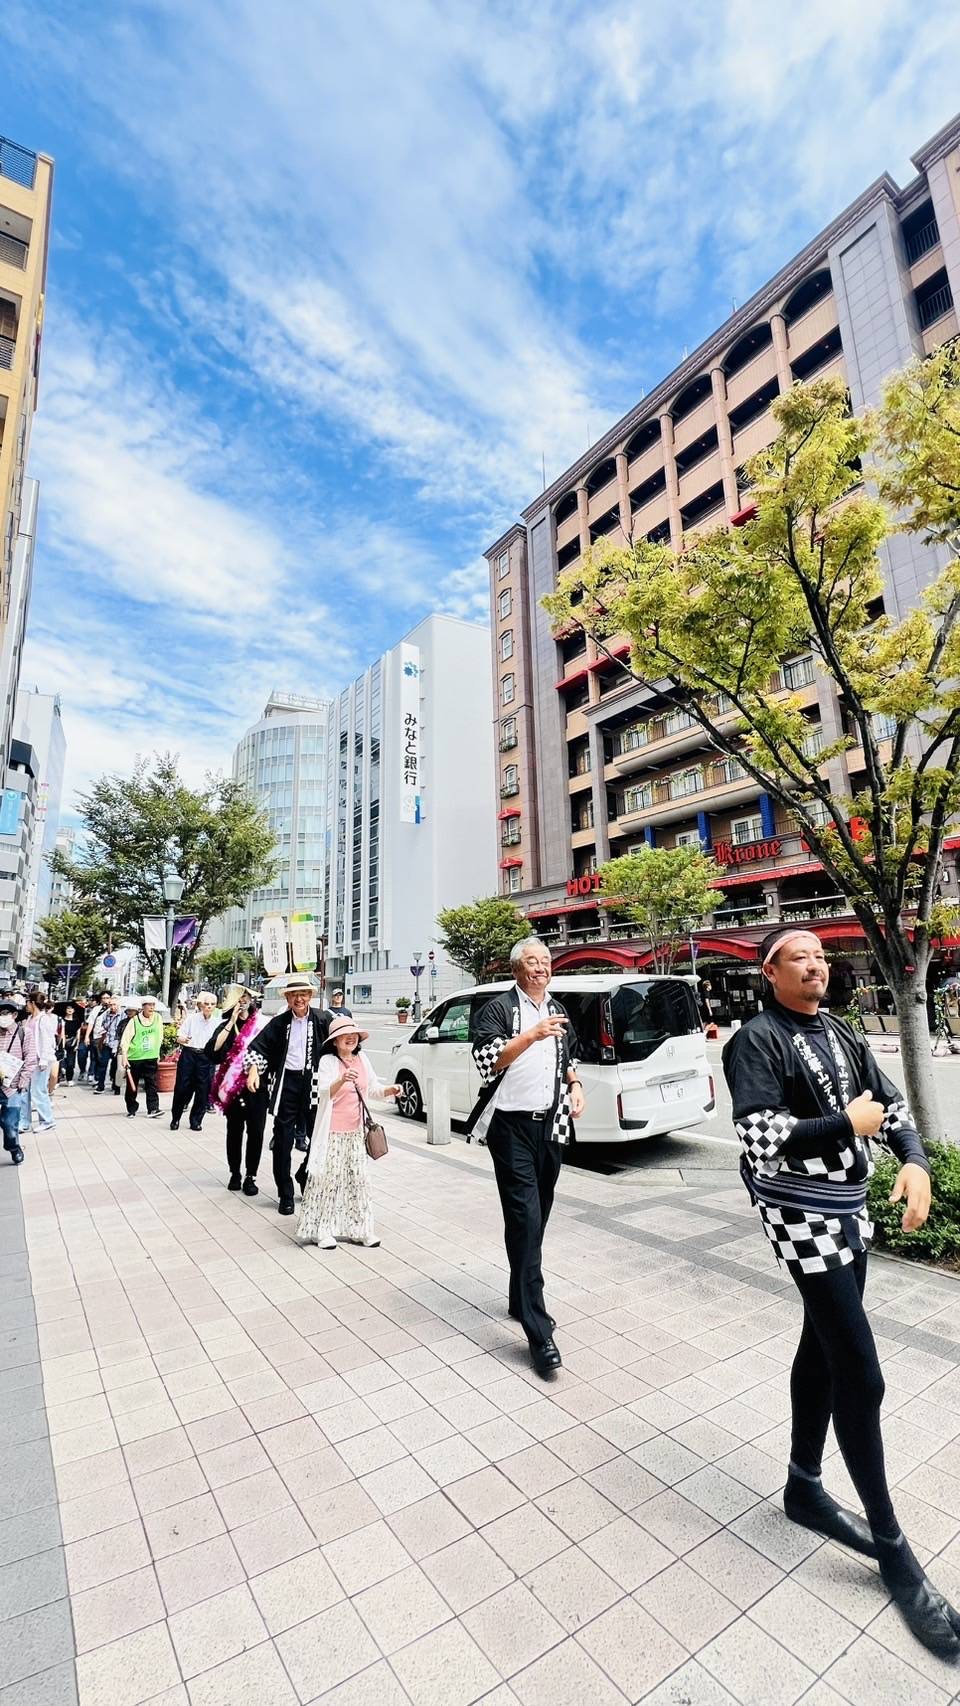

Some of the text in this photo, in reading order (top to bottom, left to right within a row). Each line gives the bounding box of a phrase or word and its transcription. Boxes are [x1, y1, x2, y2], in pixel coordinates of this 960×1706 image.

[404, 712, 418, 786] みなと銀行
[713, 838, 782, 864] Krone
